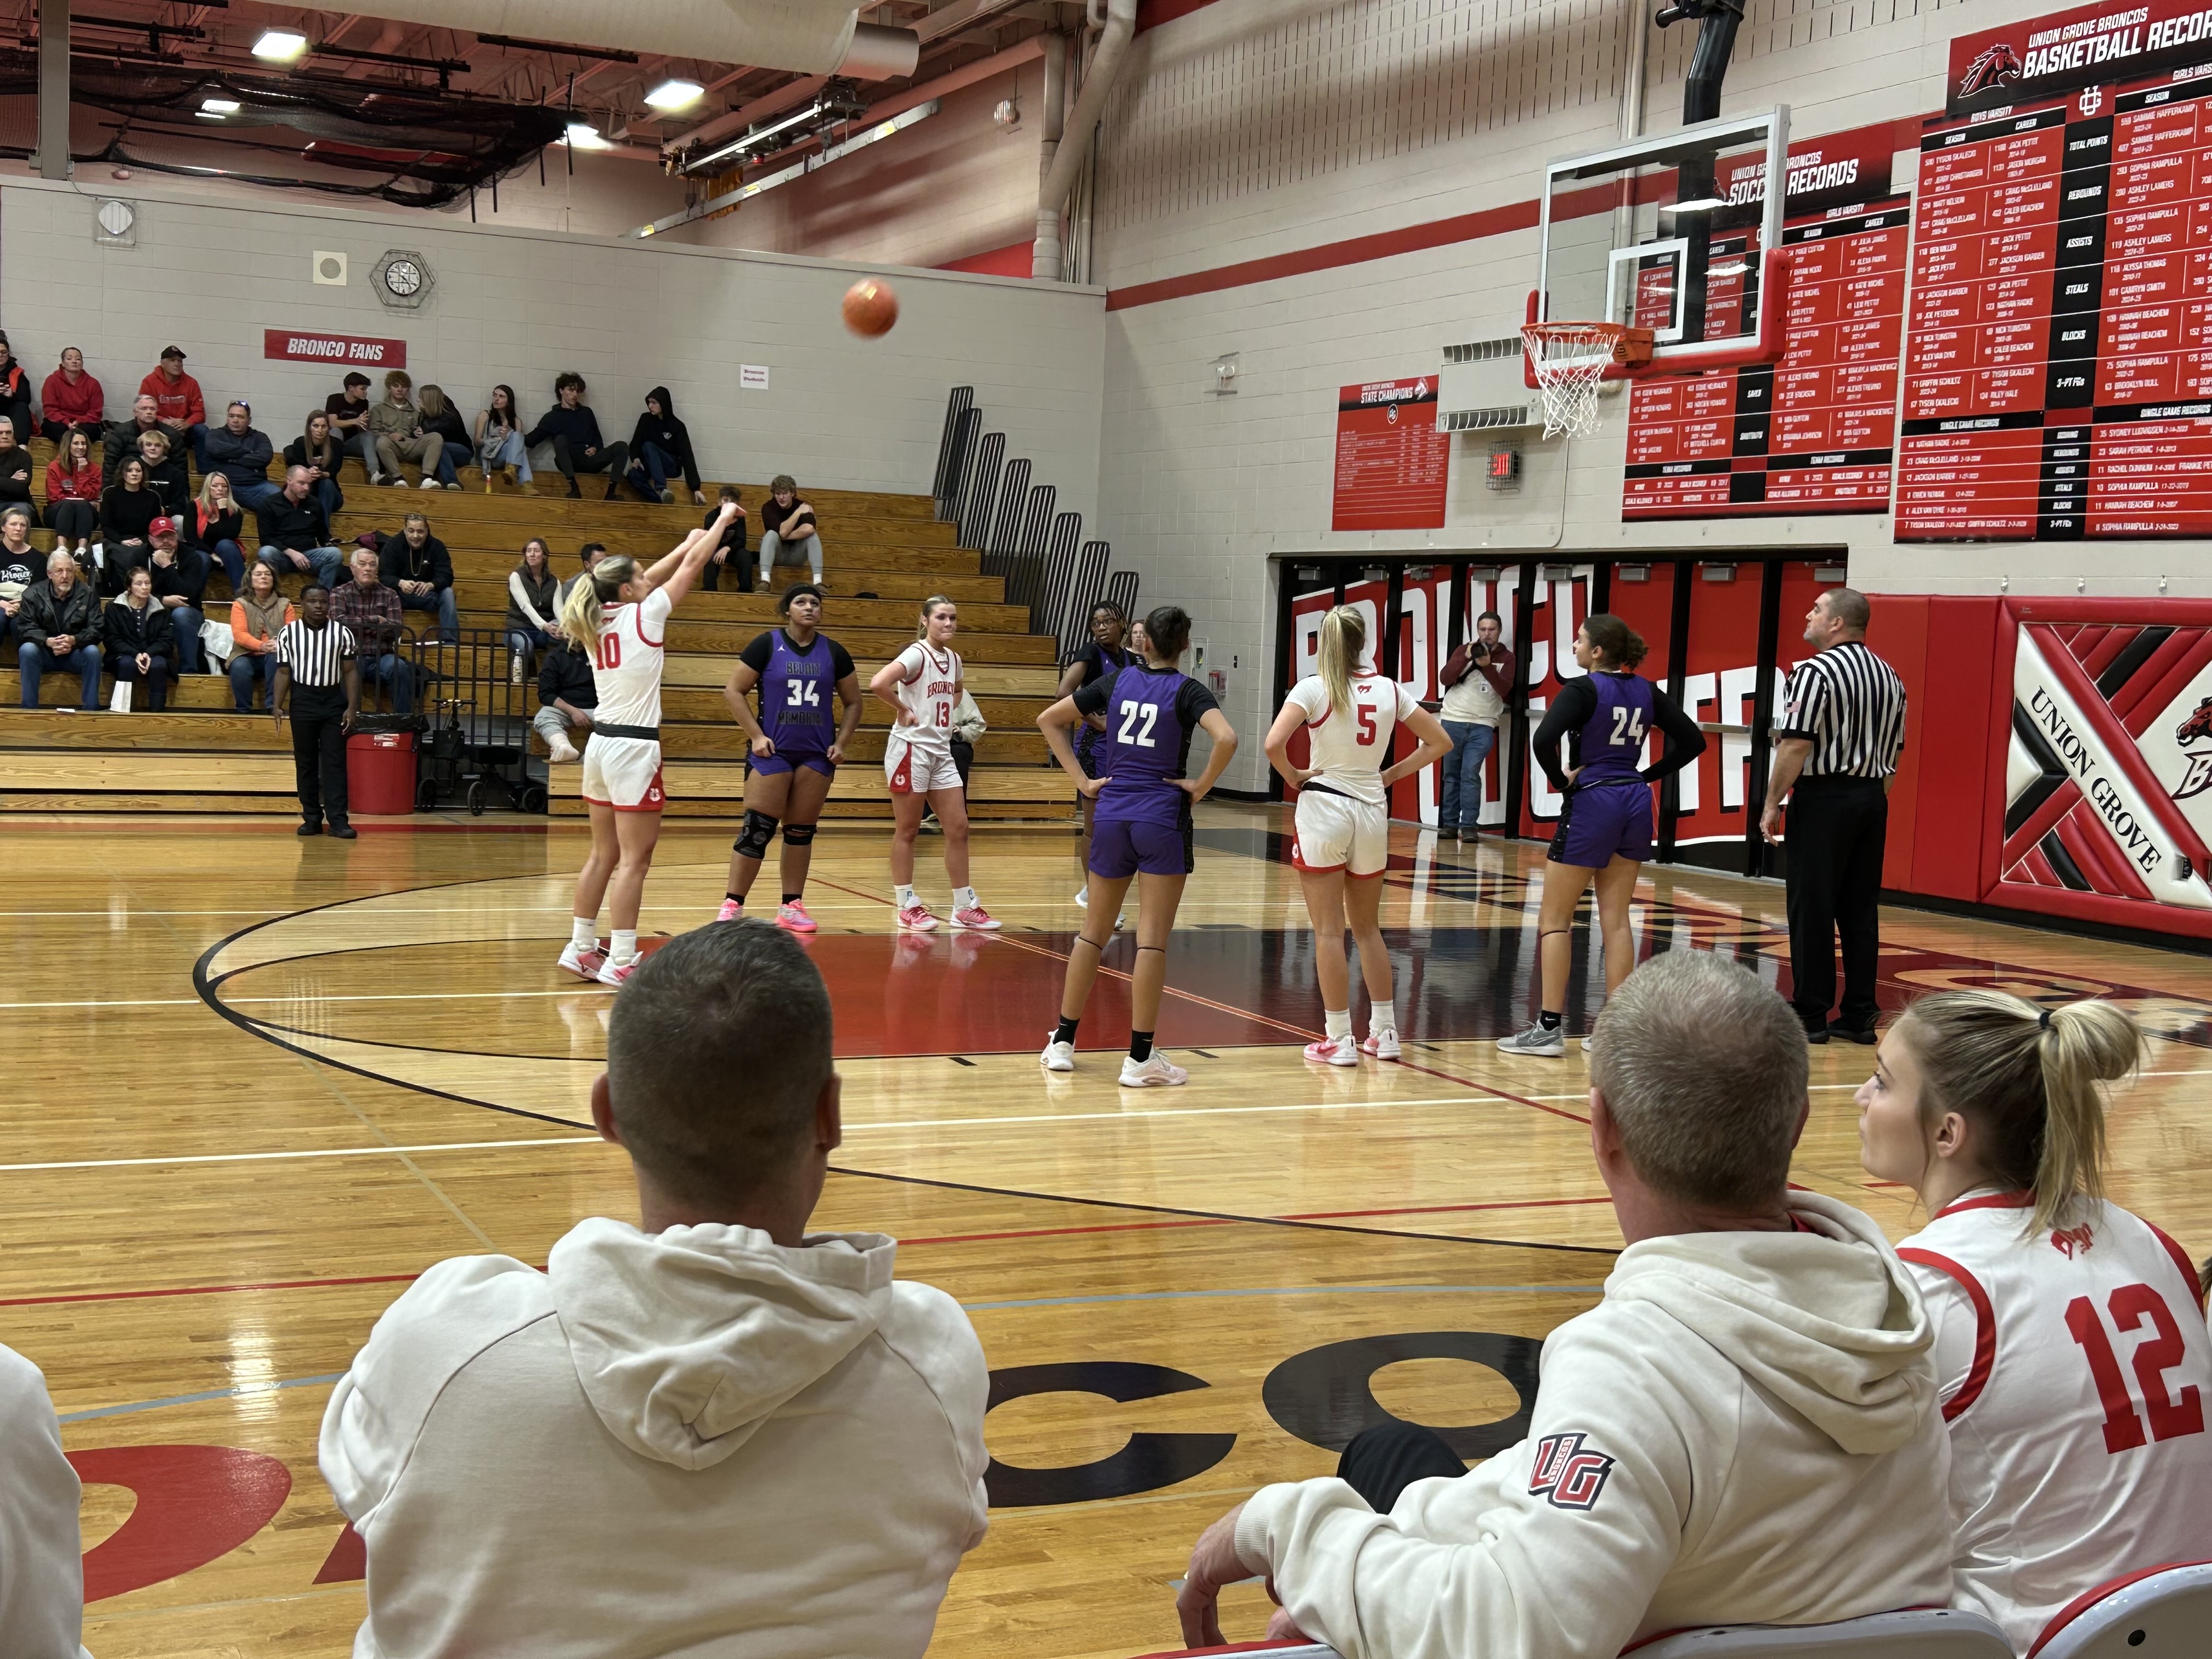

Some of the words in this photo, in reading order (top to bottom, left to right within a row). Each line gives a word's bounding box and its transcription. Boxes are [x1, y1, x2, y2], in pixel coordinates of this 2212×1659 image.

[2028, 28, 2061, 48] UNION
[2062, 19, 2096, 40] GROVE
[2098, 7, 2148, 31] BRONCOS
[2022, 27, 2141, 78] BASKETBALL
[1729, 177, 1765, 207] SOCC
[1787, 159, 1859, 195] RECORDS
[1731, 165, 1756, 182] UNION
[2065, 283, 2089, 295] STEALS
[287, 338, 345, 357] BRONCO
[349, 342, 384, 360] FANS
[1361, 391, 1377, 403] STATE
[1379, 387, 1413, 402] CHAMPIONS
[597, 632, 620, 670] 10
[787, 679, 820, 707] 34
[935, 701, 950, 727] 13
[1117, 700, 1158, 747] 22
[1356, 704, 1377, 746] 5
[1609, 707, 1644, 746] 24
[2031, 686, 2096, 778] UNION
[2091, 778, 2162, 874] GROVE
[2063, 1283, 2205, 1454] 12
[1528, 1433, 1616, 1511] UG
